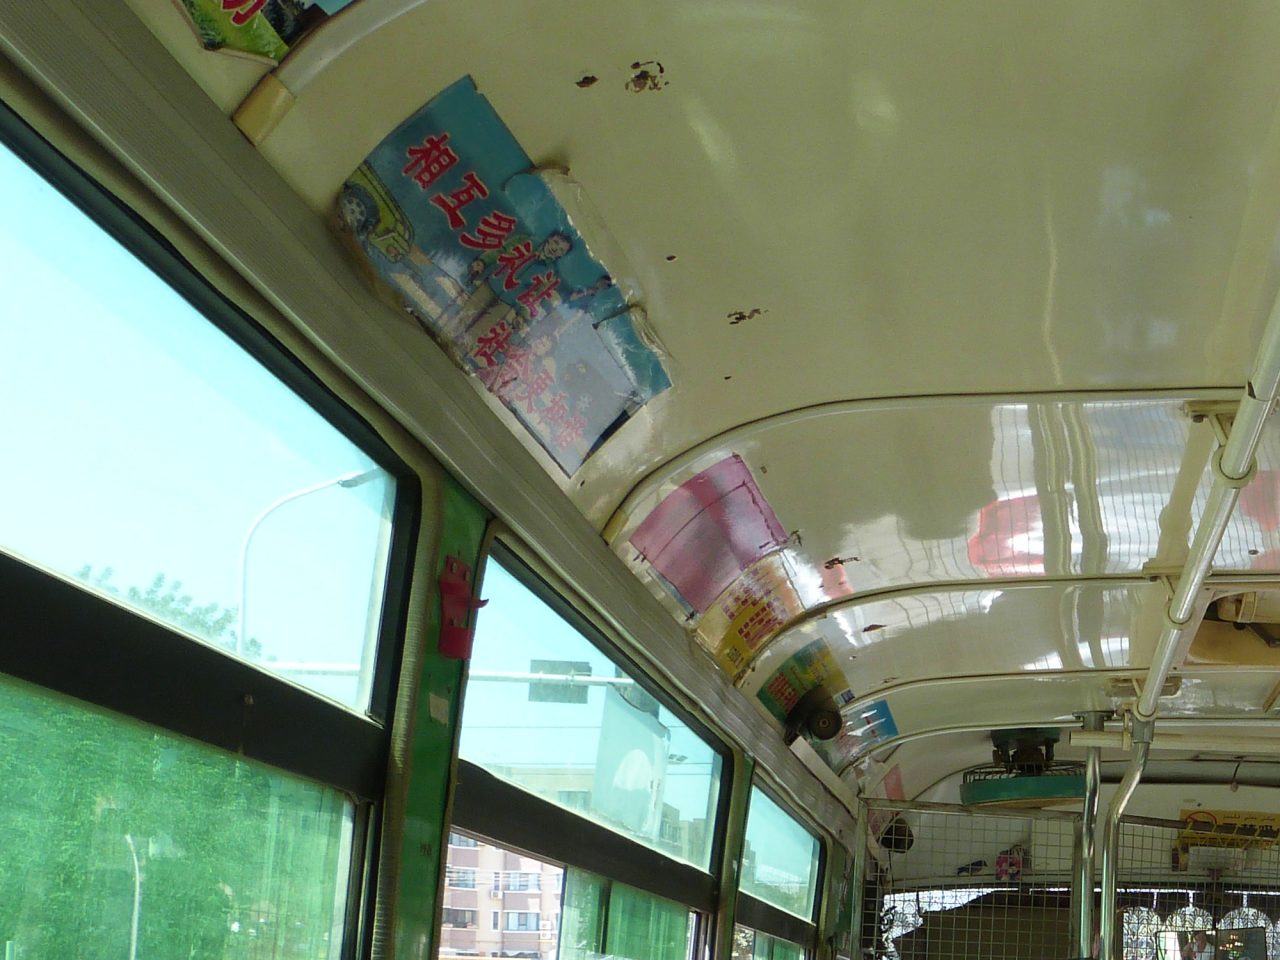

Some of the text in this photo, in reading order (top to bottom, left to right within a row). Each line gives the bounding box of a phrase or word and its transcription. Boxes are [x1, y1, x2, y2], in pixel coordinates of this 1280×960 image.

[402, 132, 560, 318] 相互多礼让
